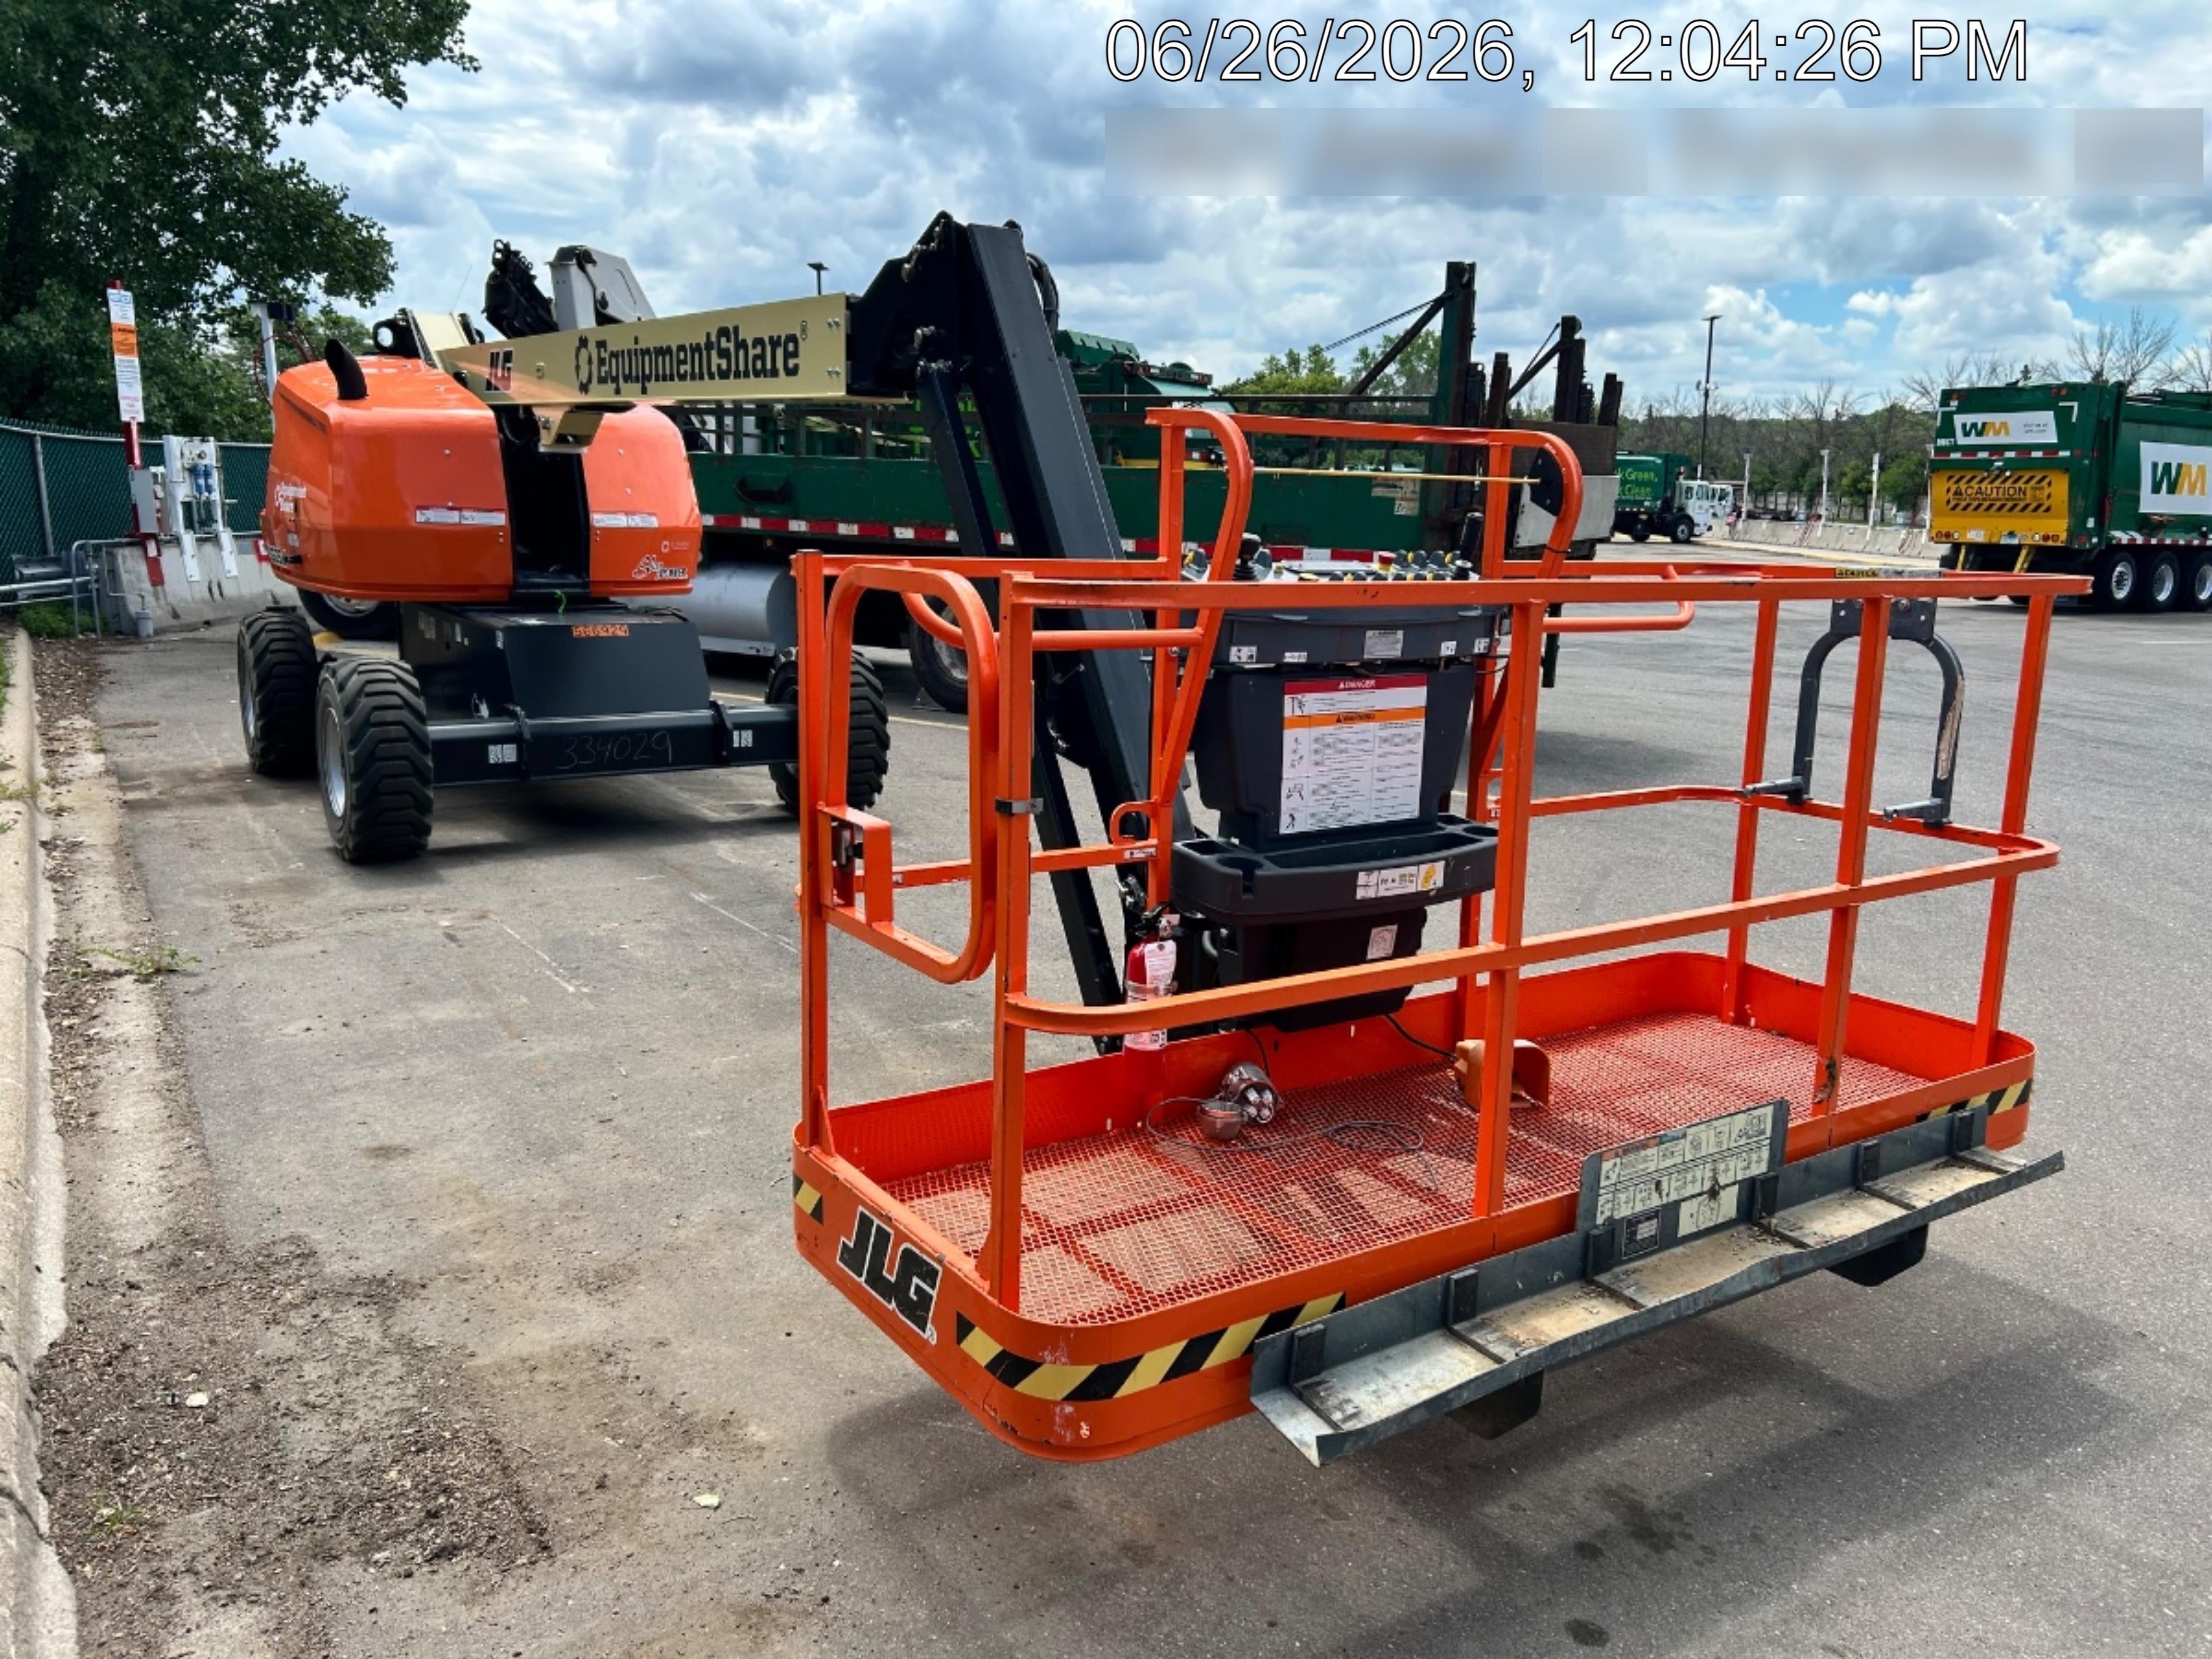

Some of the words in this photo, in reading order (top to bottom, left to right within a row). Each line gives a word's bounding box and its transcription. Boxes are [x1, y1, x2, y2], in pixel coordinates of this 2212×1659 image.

[485, 349, 512, 392] JLG
[595, 324, 800, 395] EquipmentShare
[1961, 422, 2010, 437] WM
[1965, 486, 2026, 497] CAUTION
[2151, 461, 2206, 495] WM
[556, 729, 672, 769] 334029
[837, 1206, 943, 1340] JLG
